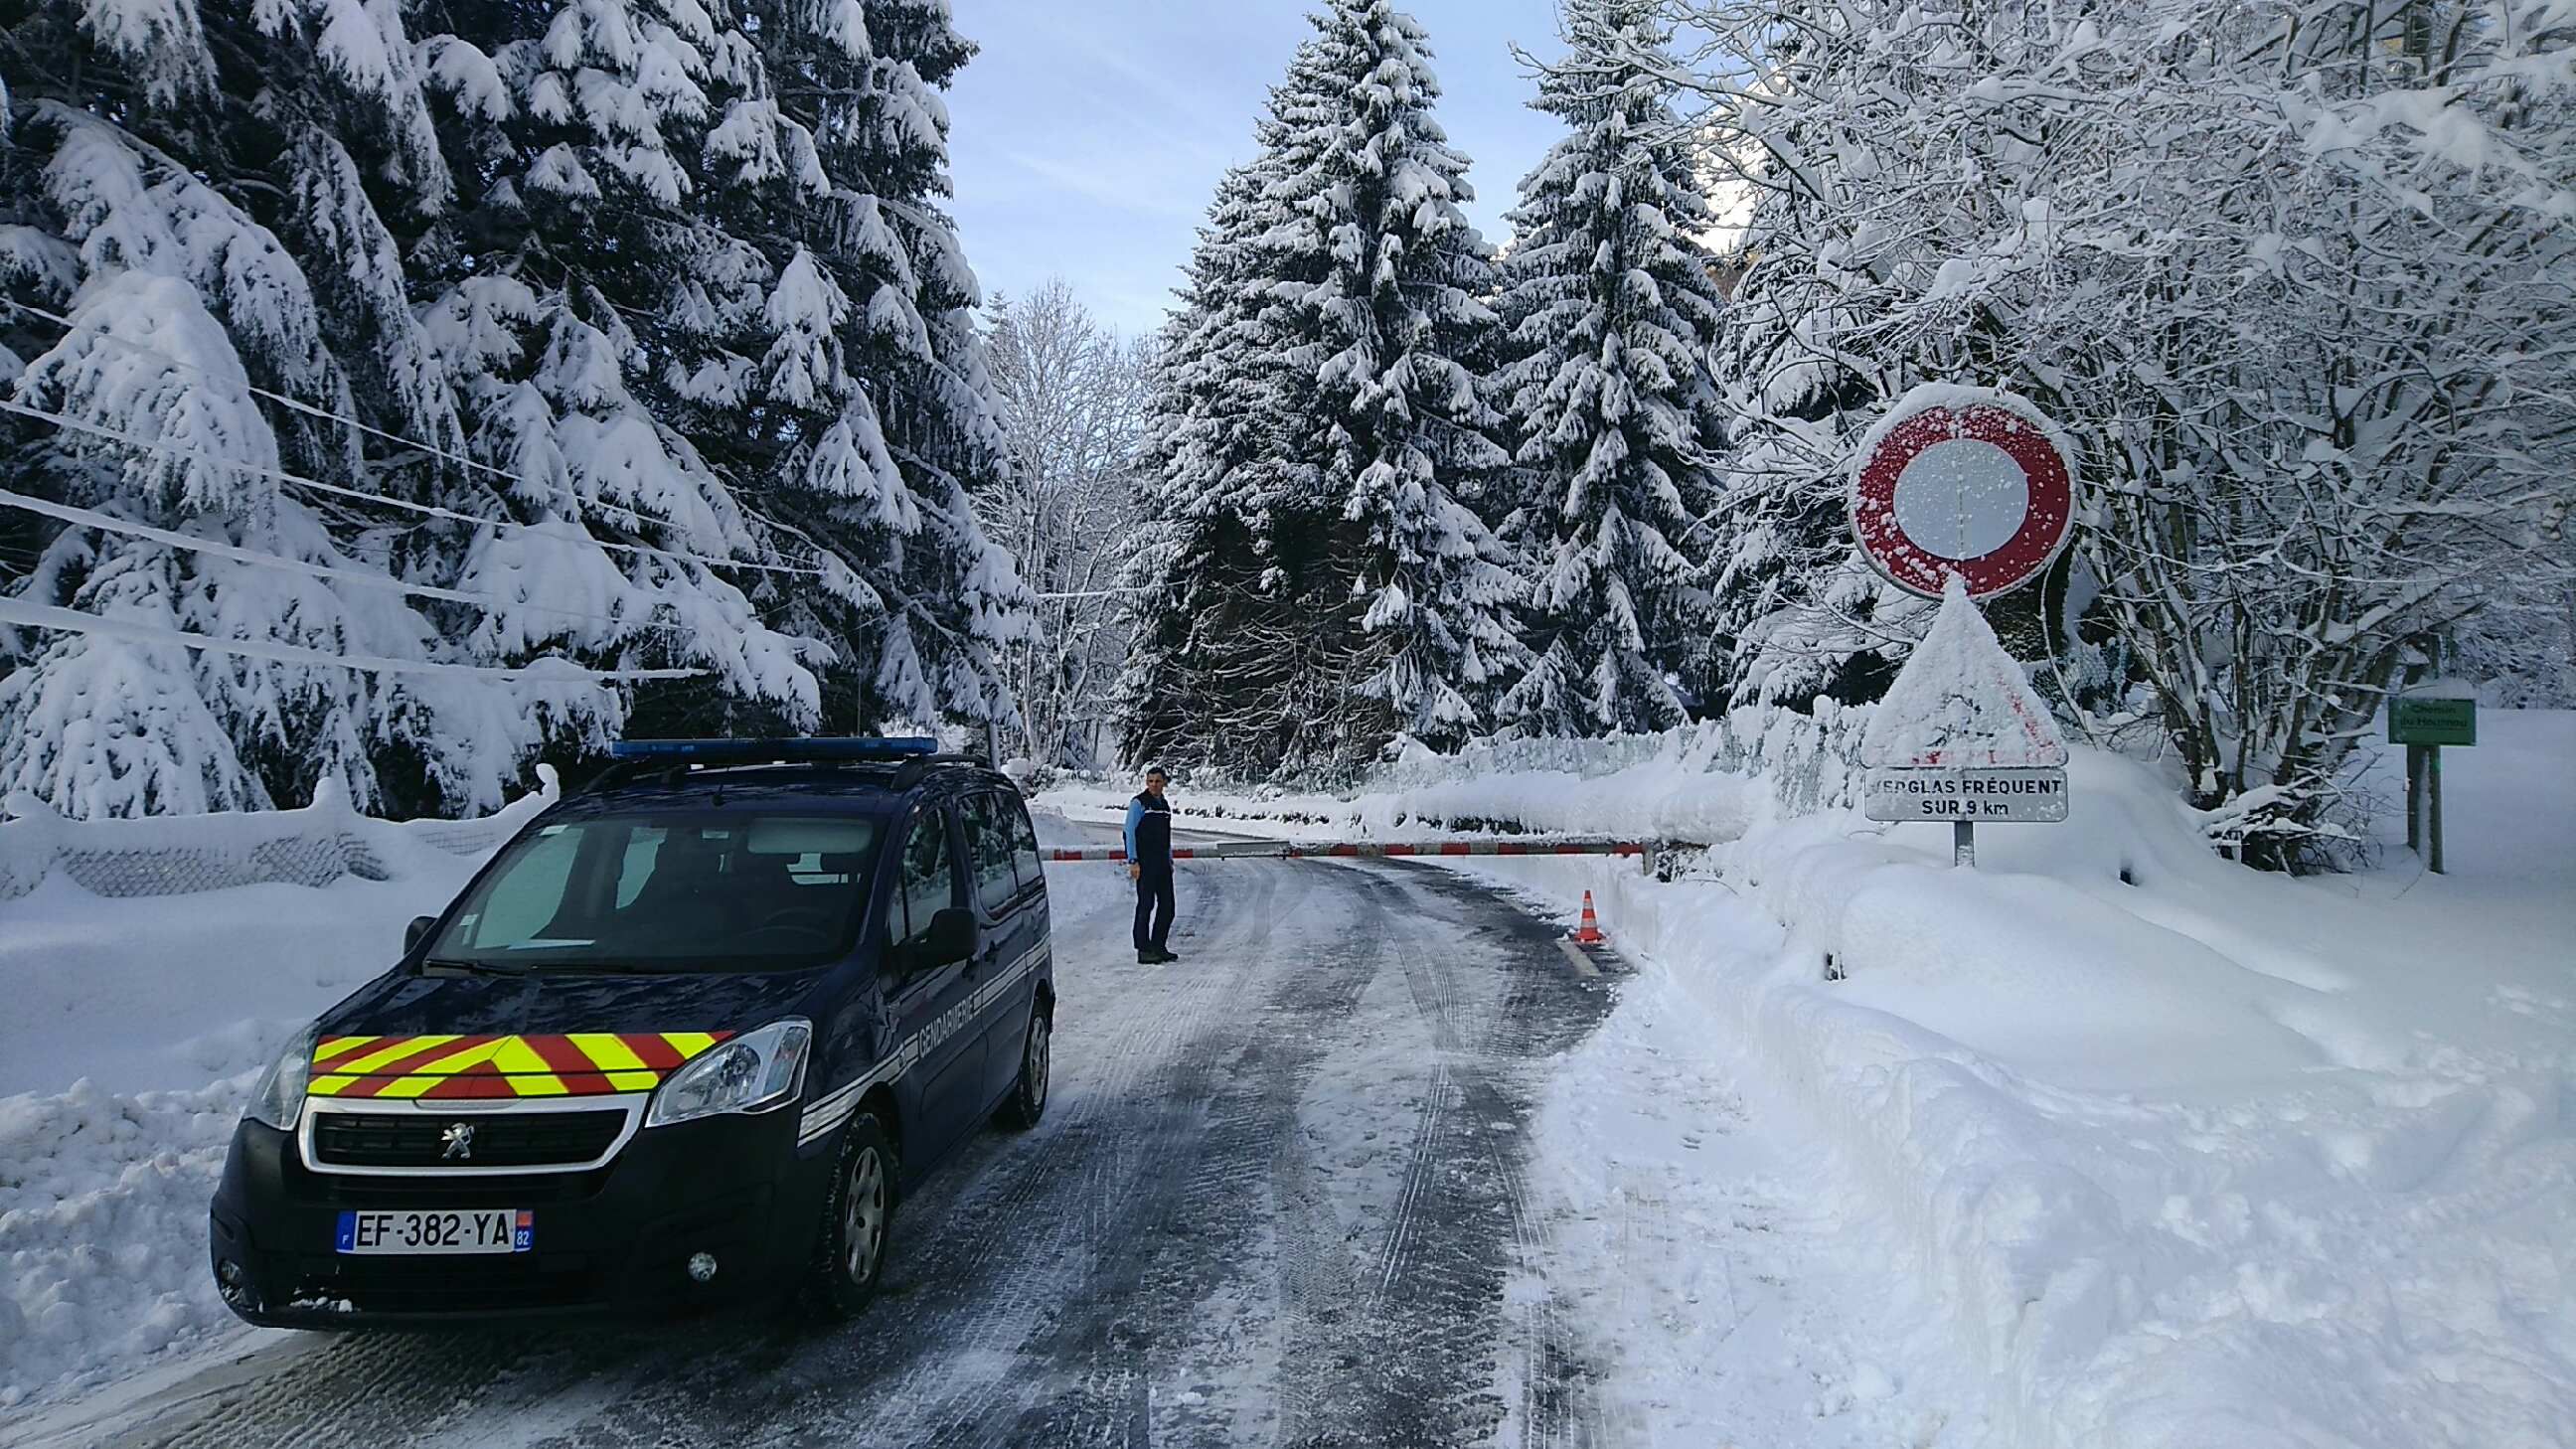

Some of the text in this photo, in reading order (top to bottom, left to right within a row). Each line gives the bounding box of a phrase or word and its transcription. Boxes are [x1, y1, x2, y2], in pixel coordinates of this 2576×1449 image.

[1962, 777, 2062, 795] FRÉQUENT
[1922, 800, 2009, 815] SUR 9 km
[919, 994, 974, 1058] GENDARMERIE
[342, 1213, 530, 1247] F EF-382-YA 82
